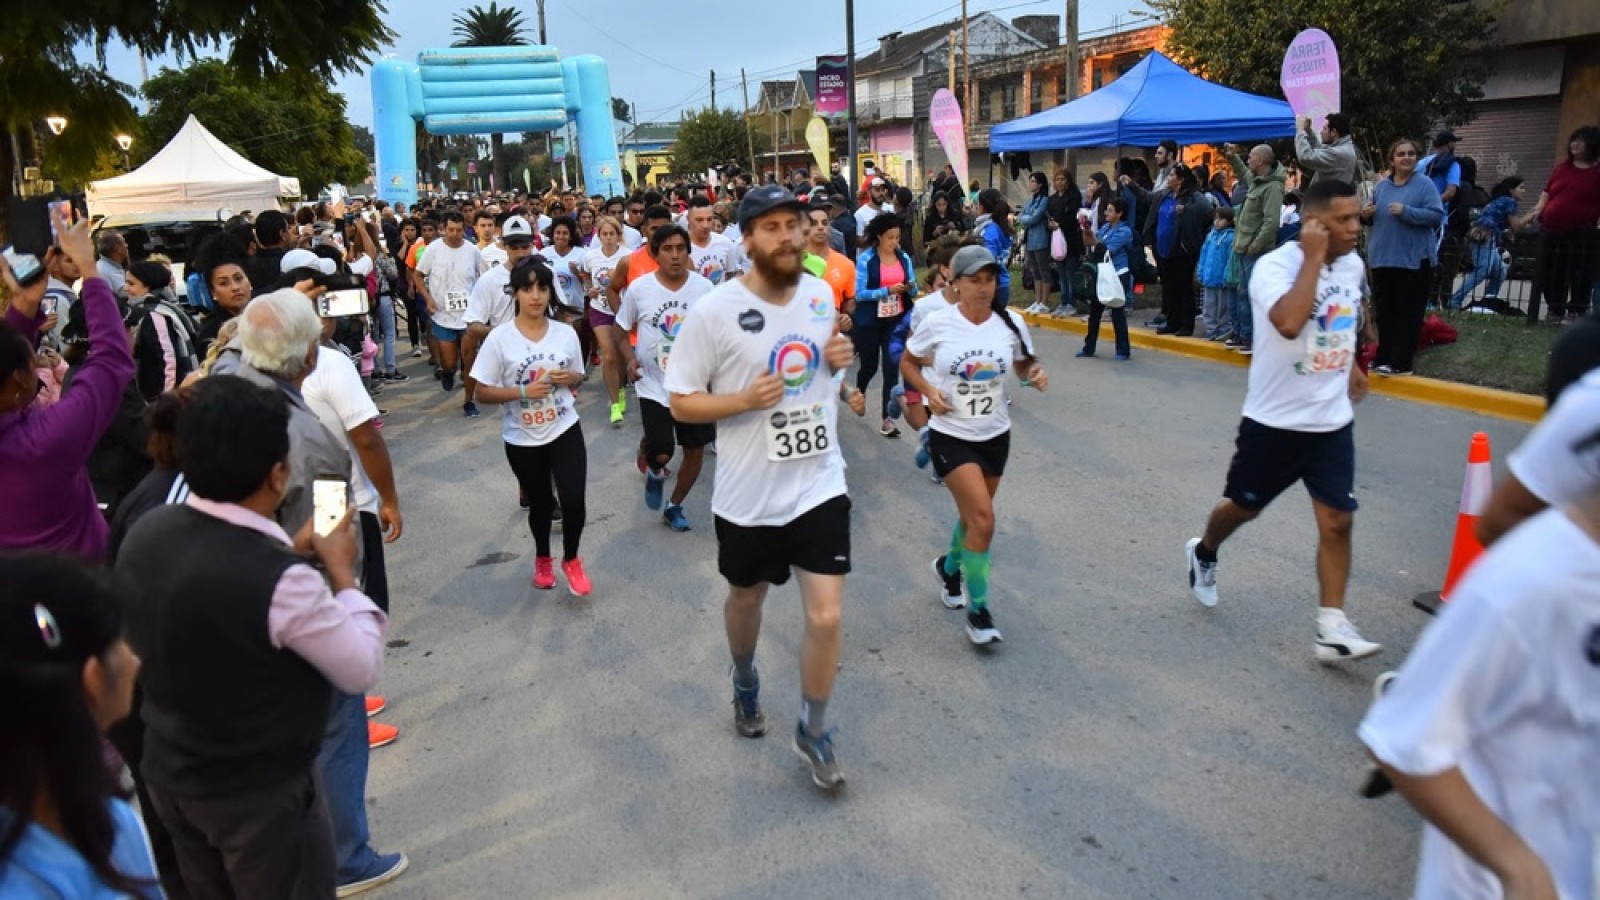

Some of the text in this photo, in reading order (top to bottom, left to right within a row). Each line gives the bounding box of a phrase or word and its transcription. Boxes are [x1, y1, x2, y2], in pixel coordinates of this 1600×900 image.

[1313, 349, 1350, 371] 922
[522, 408, 556, 425] 983
[967, 396, 993, 416] 12
[775, 425, 828, 458] 388
